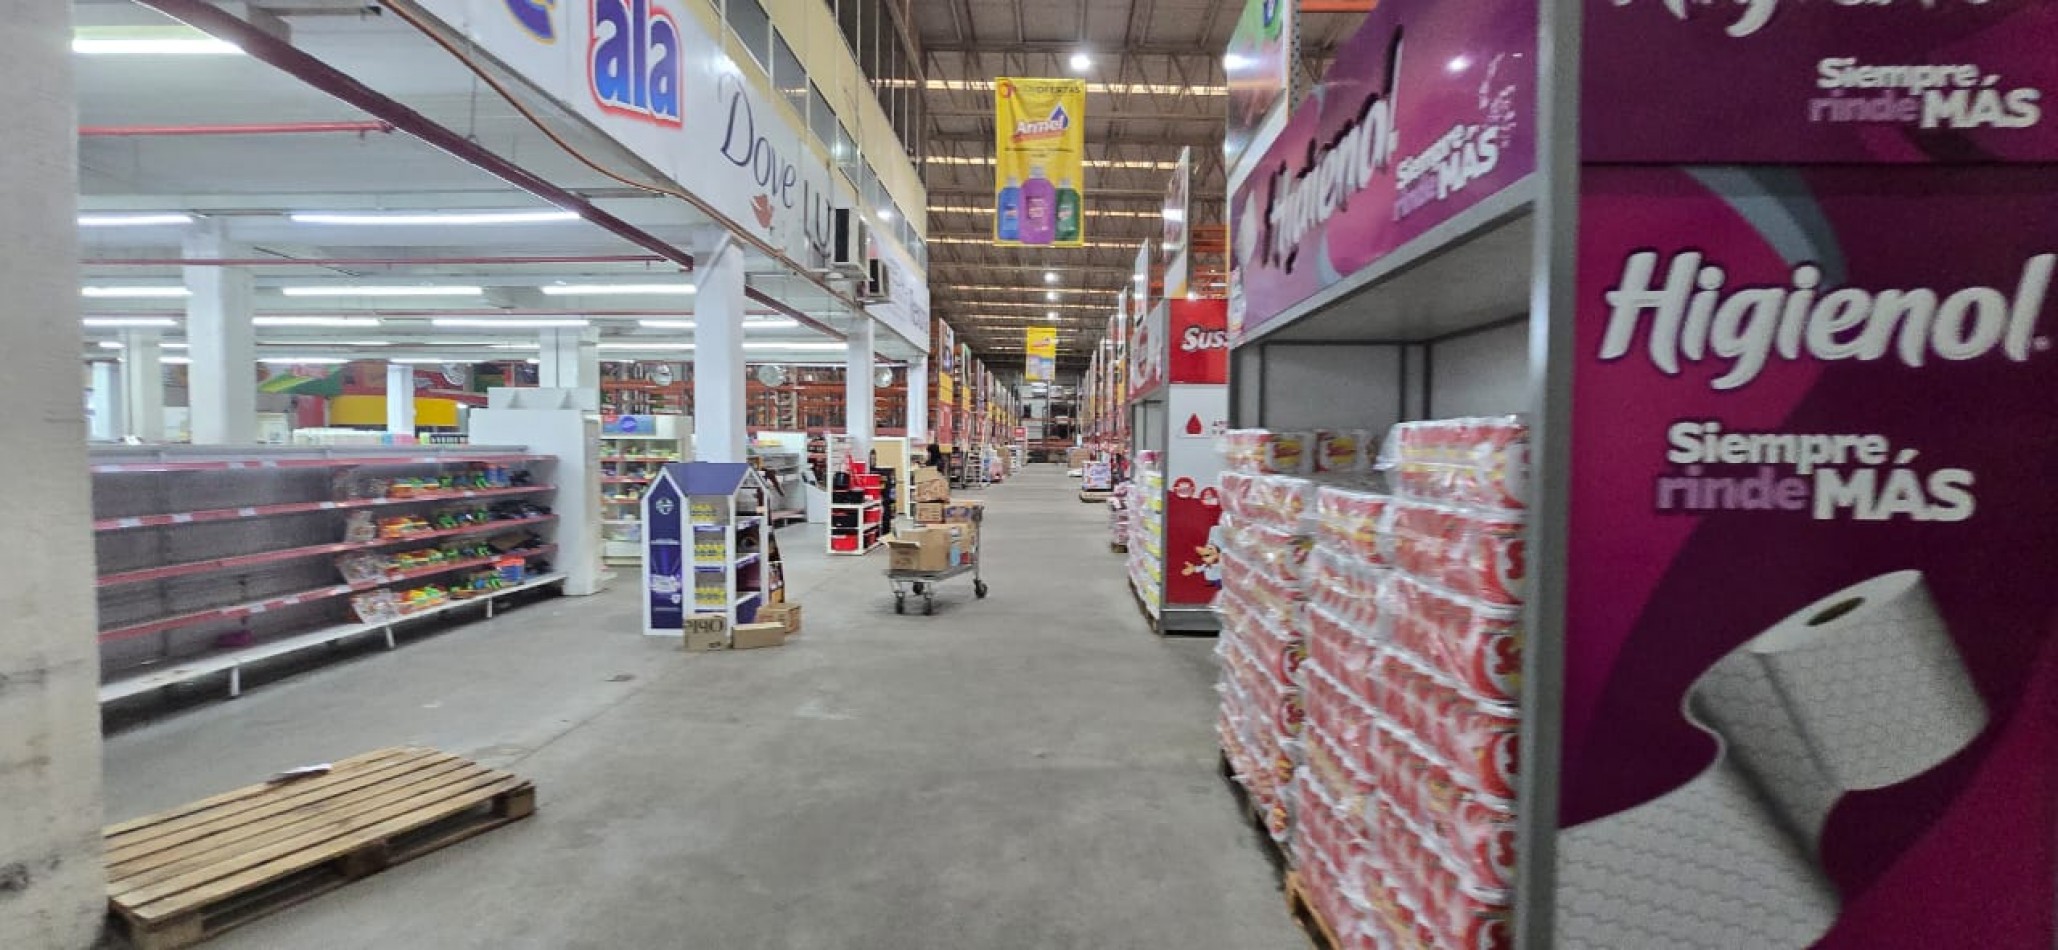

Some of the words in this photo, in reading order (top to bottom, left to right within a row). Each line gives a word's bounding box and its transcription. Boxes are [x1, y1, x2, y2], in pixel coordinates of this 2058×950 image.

[586, 0, 687, 128] ala
[1816, 57, 1979, 92] Siempre
[1808, 90, 1918, 123] rinde
[1919, 74, 2041, 129] MÁS
[720, 91, 797, 209] Dove
[1599, 251, 2058, 390] Higienol
[1655, 466, 1811, 512] rinde
[1812, 448, 1977, 522] MÁS
[1666, 421, 1889, 479] Siempre
